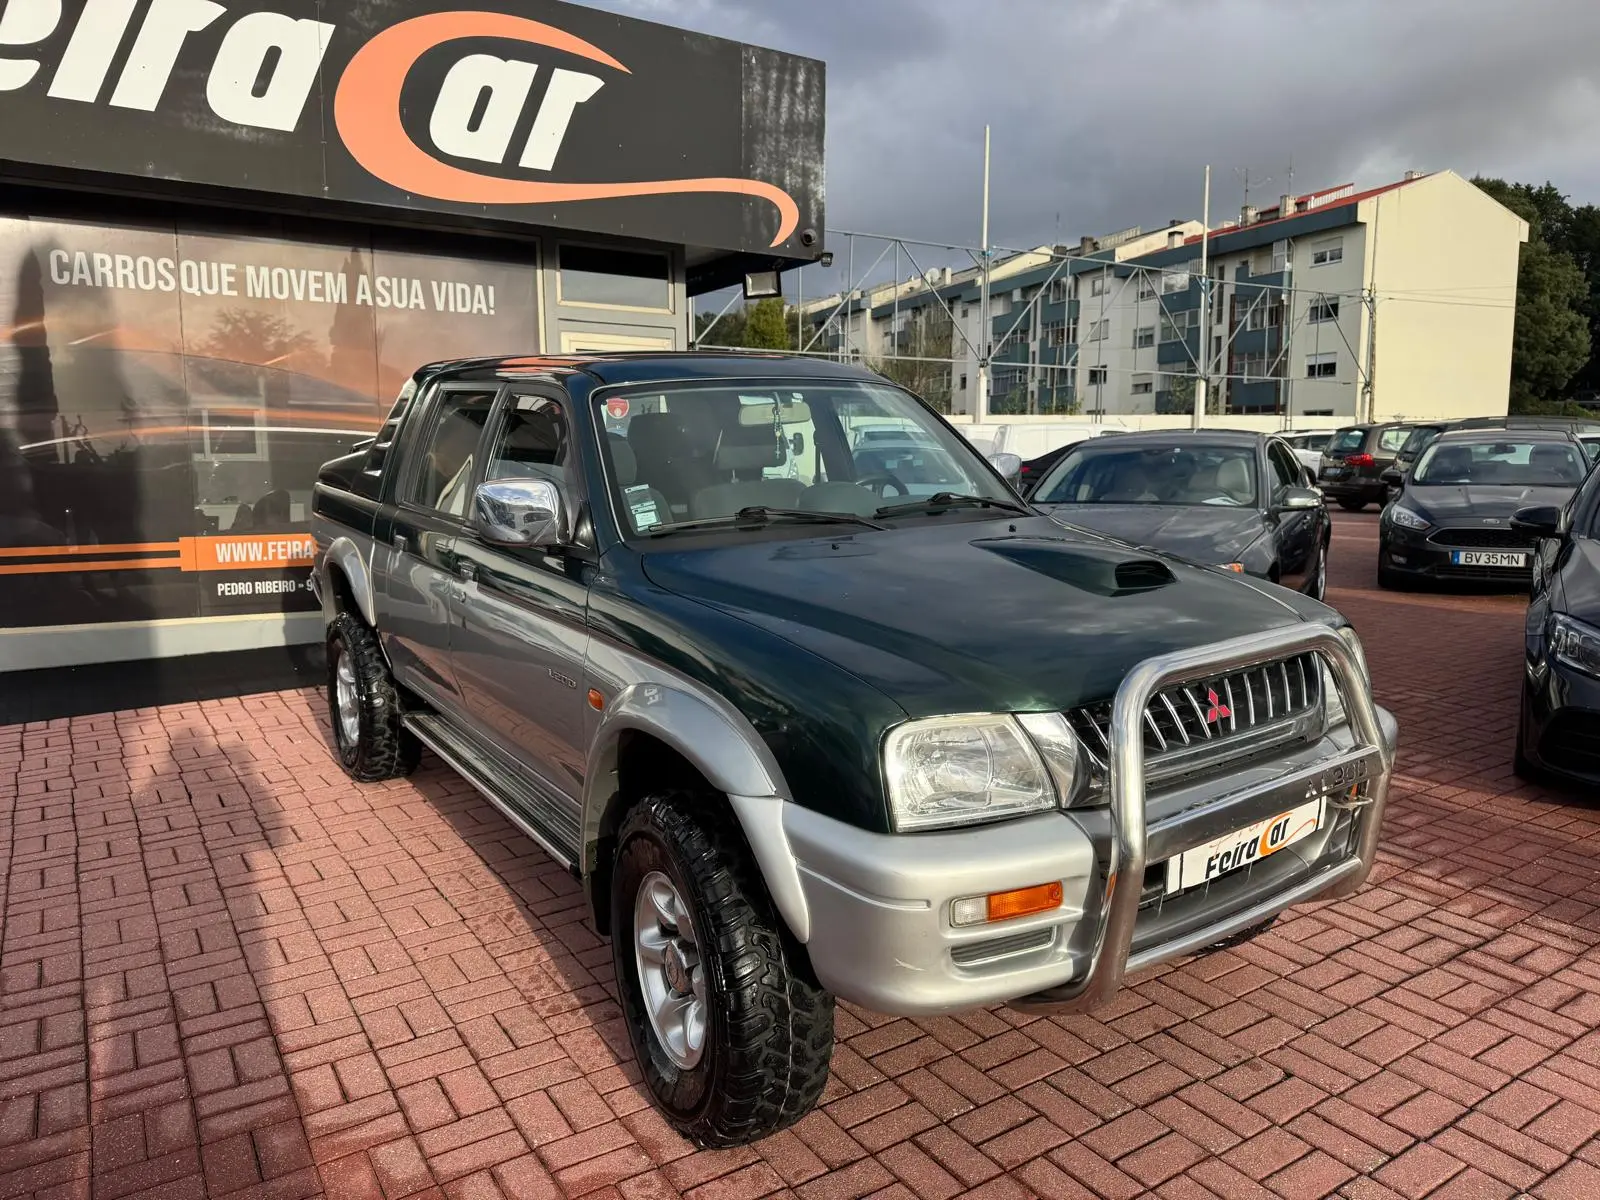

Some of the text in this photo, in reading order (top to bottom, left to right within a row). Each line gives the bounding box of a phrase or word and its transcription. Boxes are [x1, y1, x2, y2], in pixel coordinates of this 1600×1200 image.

[50, 250, 495, 315] CARROS QUE MOVEM A SUA VIDA!
[215, 540, 314, 563] WWW.FEIRA
[1464, 552, 1519, 565] BV 35 MN
[217, 582, 252, 596] PEDRO
[255, 580, 296, 594] RIBEIRO
